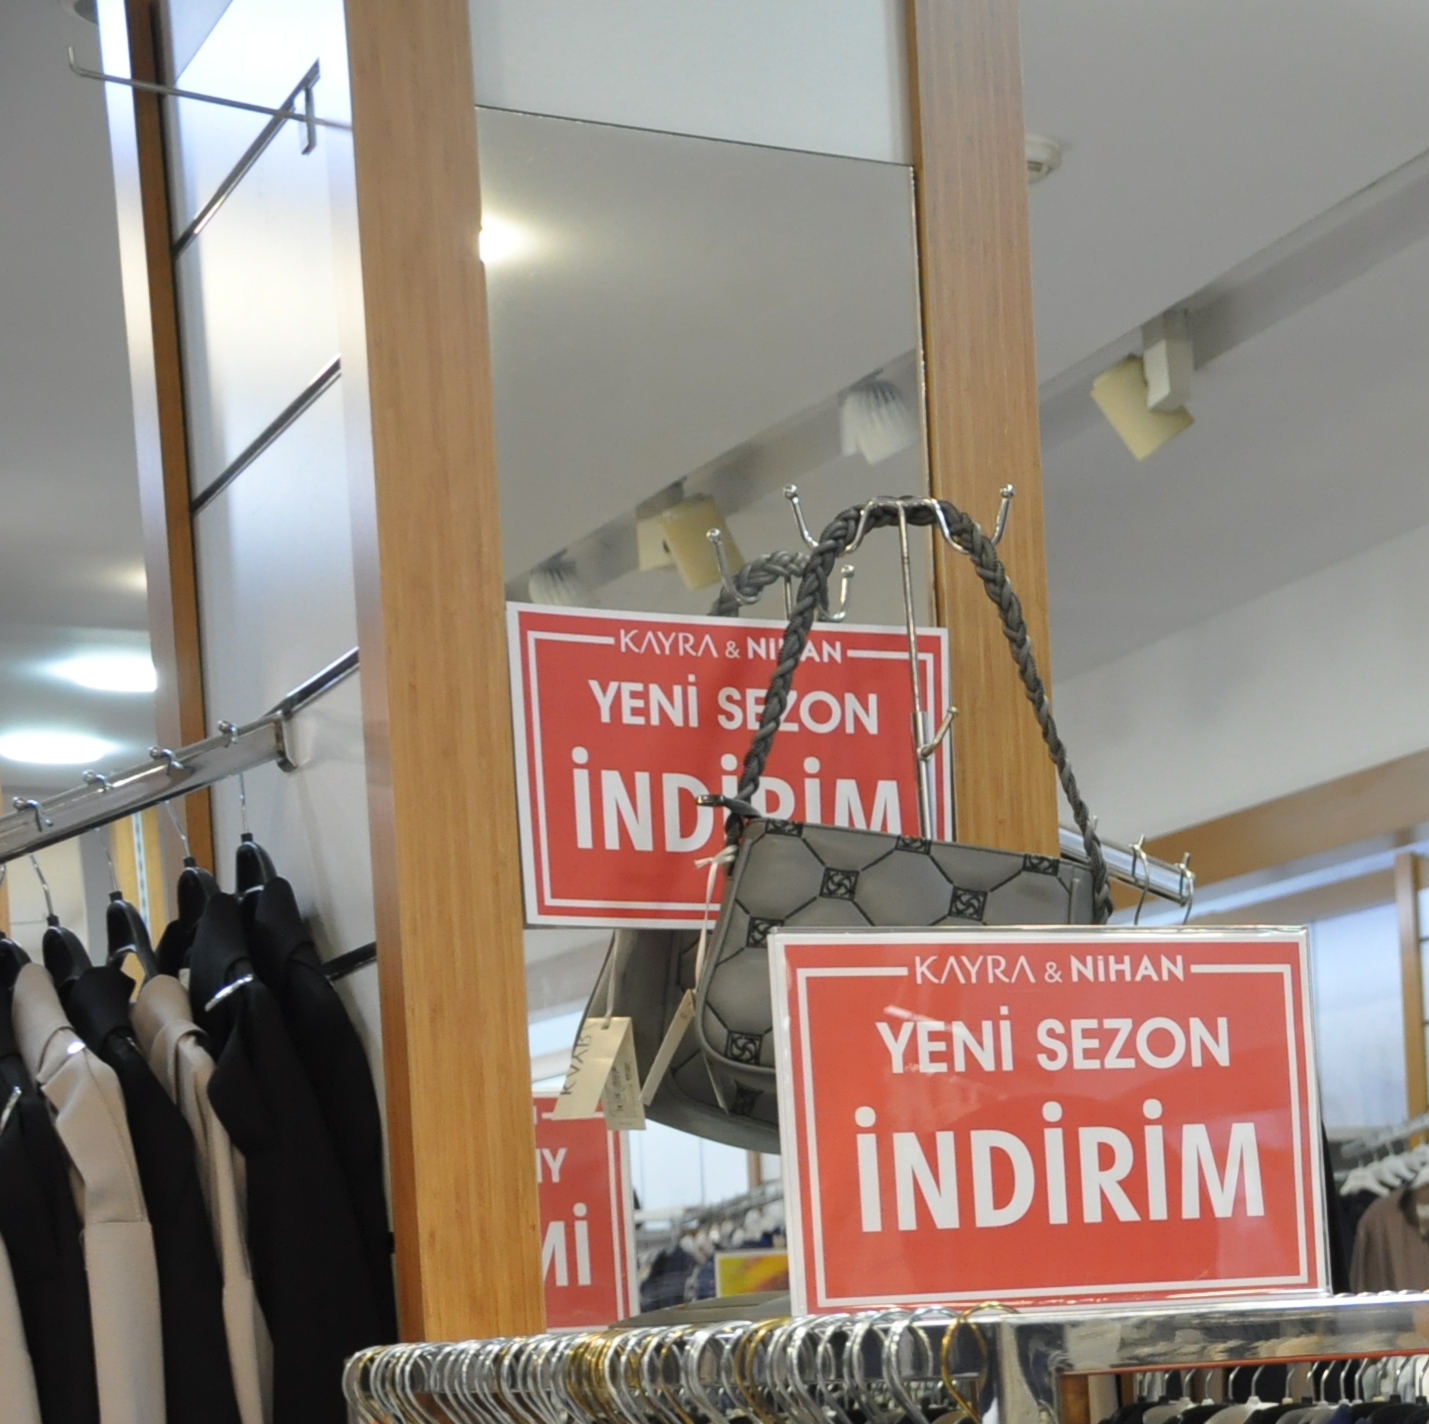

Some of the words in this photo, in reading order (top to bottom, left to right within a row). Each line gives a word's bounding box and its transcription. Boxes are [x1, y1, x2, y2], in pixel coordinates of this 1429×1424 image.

[619, 628, 719, 658] KAYRA
[725, 640, 740, 659] &
[747, 636, 843, 664] NiAN
[588, 673, 699, 728] YENİ
[915, 955, 1036, 984] KAYRA
[1044, 961, 1063, 984] &
[875, 1005, 1014, 1074] YENİ
[1036, 1017, 1231, 1072] SEZON
[854, 1098, 1265, 1233] İNDİRİM
